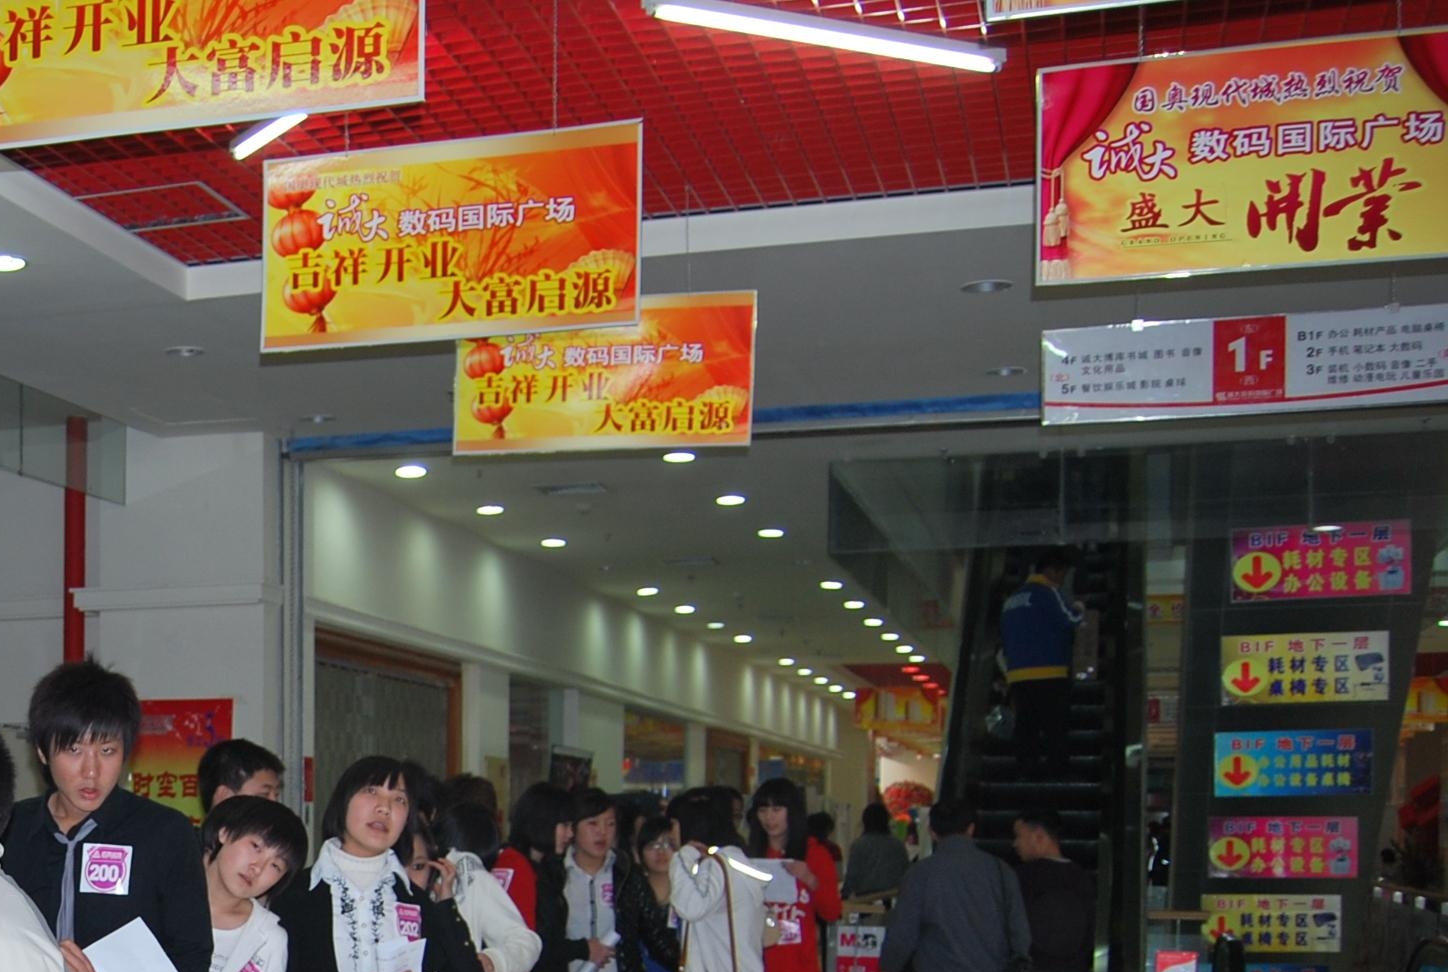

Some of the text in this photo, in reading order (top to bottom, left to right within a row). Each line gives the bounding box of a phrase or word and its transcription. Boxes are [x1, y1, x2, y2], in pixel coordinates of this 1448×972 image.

[148, 21, 387, 103] 大富启源
[1133, 63, 1404, 113] 国奥现代城热烈祝贺
[1188, 110, 1447, 164] 数码国际广场
[398, 196, 576, 238] 数码国际广场
[1120, 189, 1225, 233] 盛大
[288, 239, 462, 291] 吉祥开业
[439, 268, 614, 321] 大富启源
[1297, 330, 1323, 341] B1F
[1306, 346, 1323, 358] 2F
[1328, 345, 1350, 356] 手机
[563, 342, 705, 367] 数码国际广场
[1082, 363, 1126, 376] 文化用品
[1227, 336, 1274, 373] 1F
[1306, 363, 1323, 375] 3F
[478, 371, 612, 406] 吉祥开业
[1061, 383, 1077, 395] 5F
[594, 401, 732, 434] 大富启源
[1288, 636, 1370, 653] 地下一层
[1268, 654, 1351, 674] 耗材专区
[89, 863, 121, 882] 200
